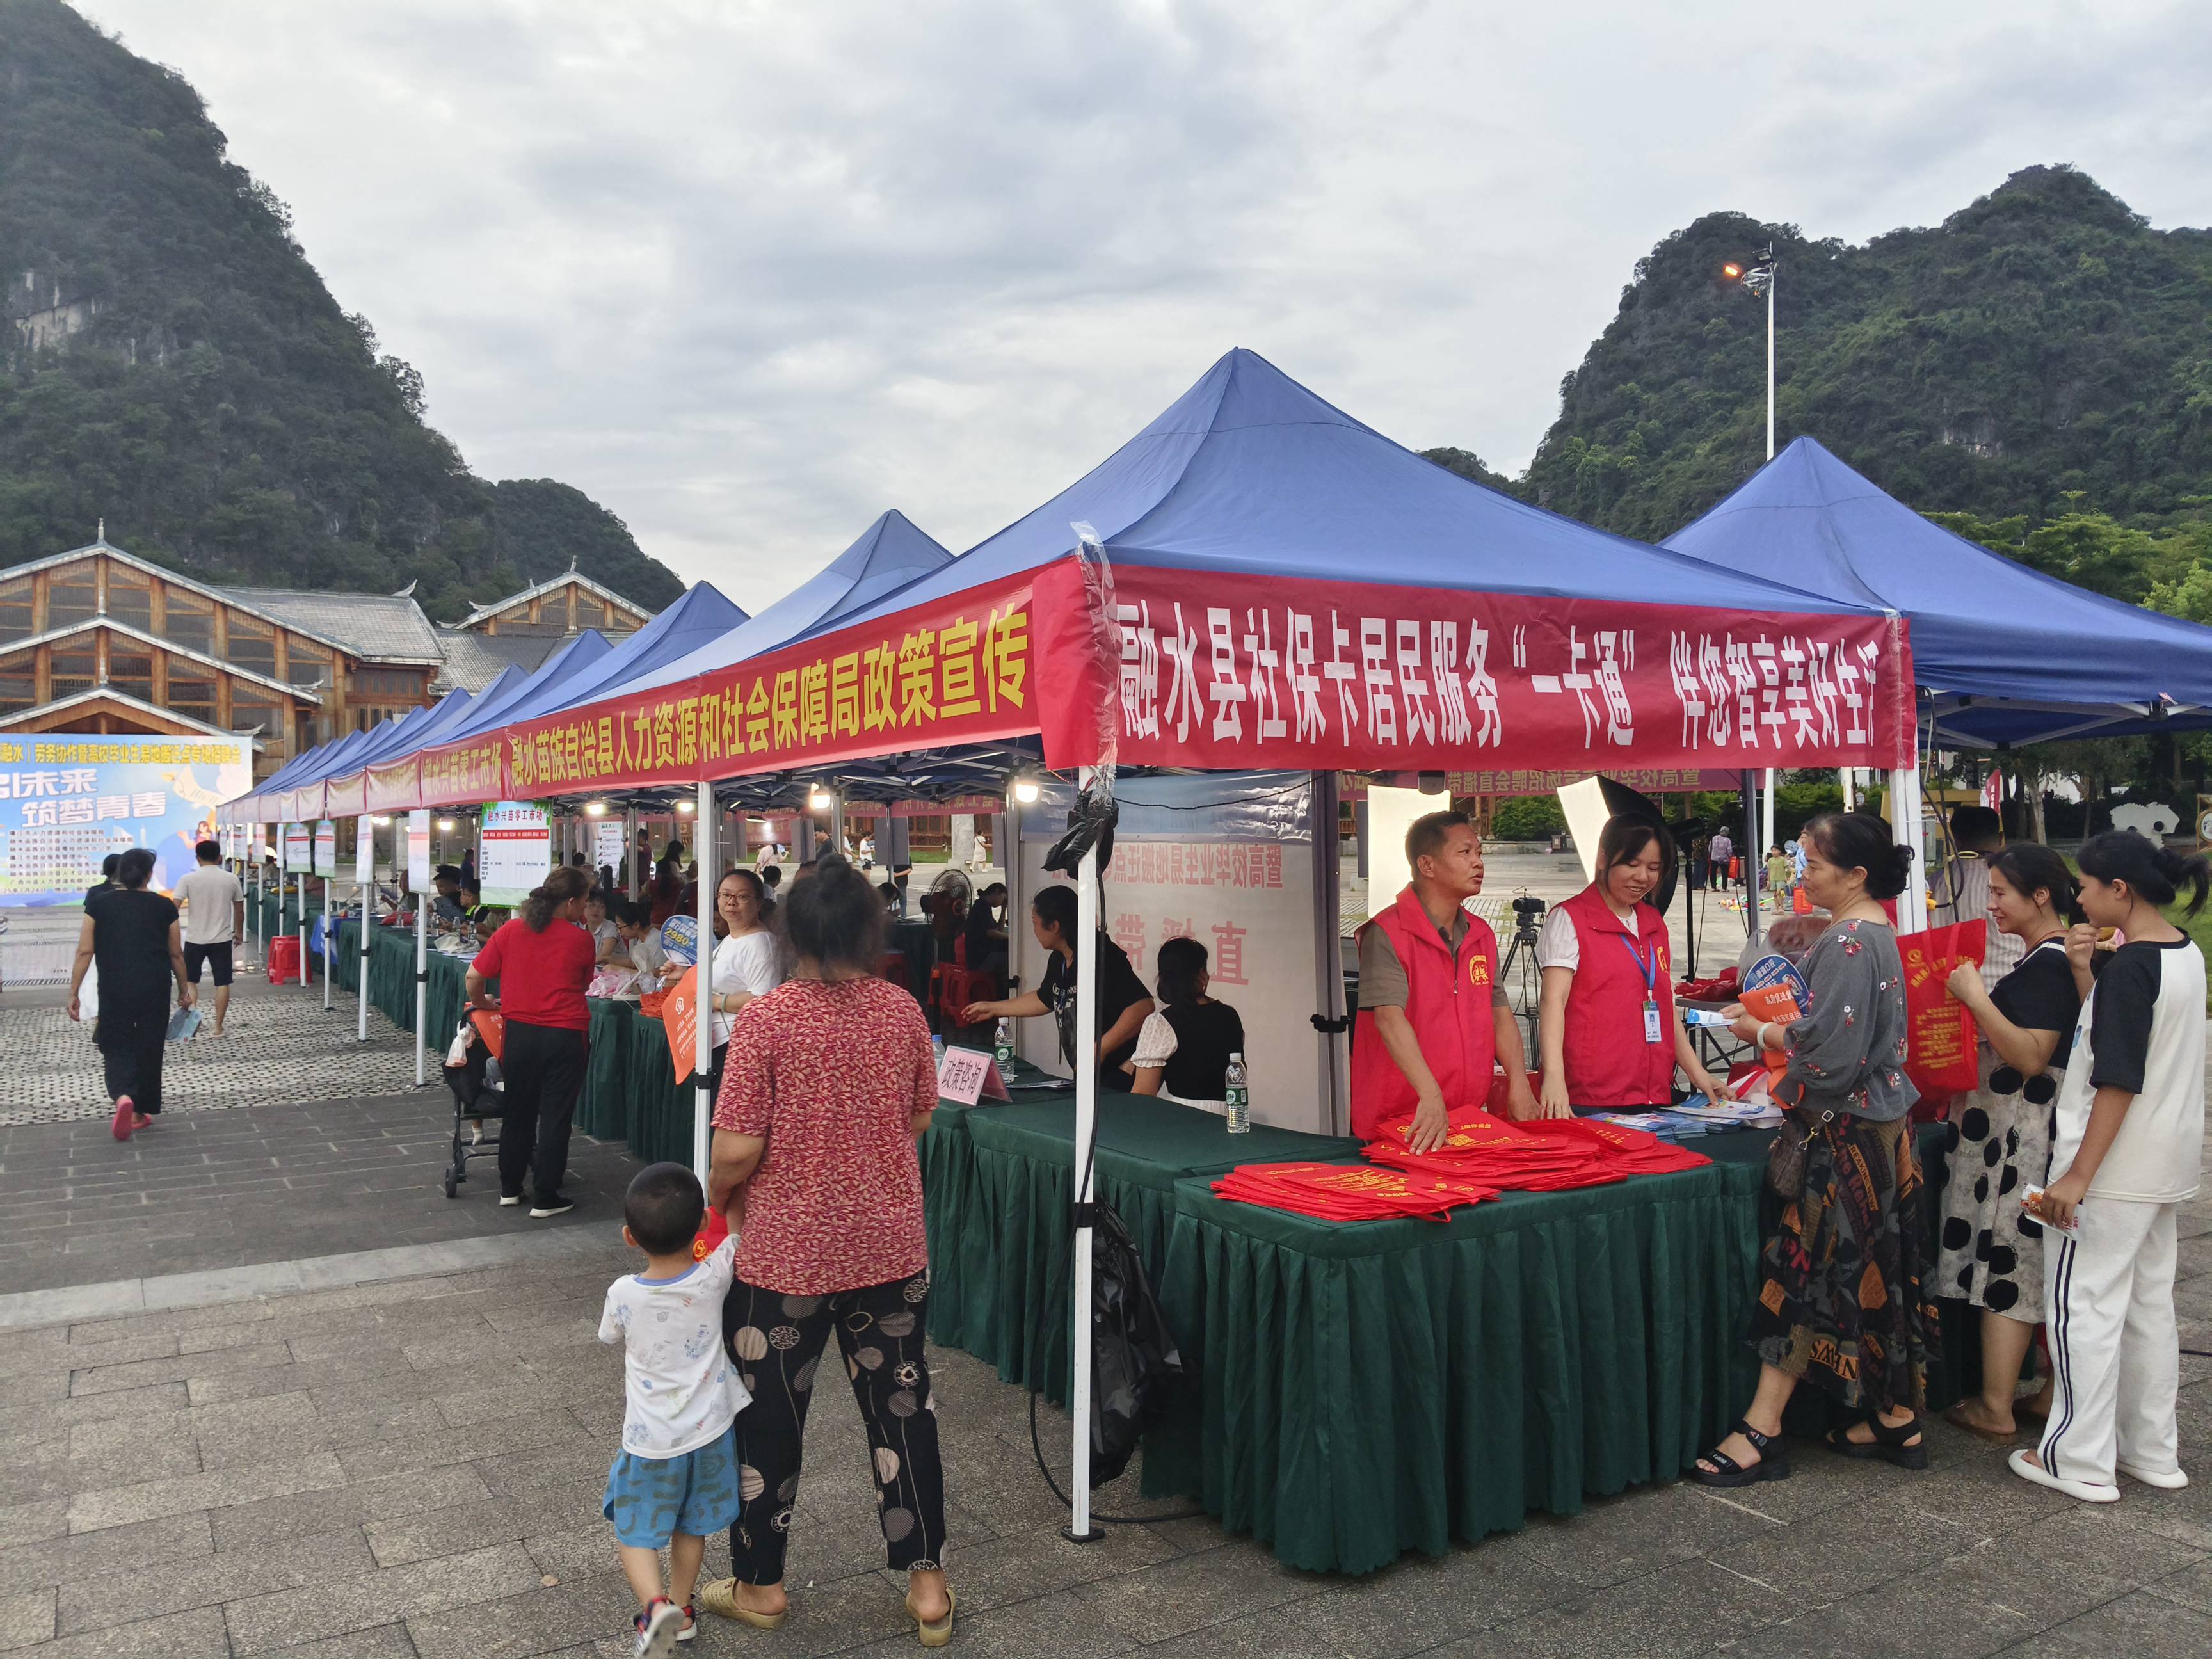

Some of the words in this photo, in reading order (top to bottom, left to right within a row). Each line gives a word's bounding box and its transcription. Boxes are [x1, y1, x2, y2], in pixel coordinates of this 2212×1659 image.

[511, 602, 1027, 787] 融水苗族自治县人力资源和社会保障局政策宣传
[423, 741, 502, 796] 融水兴苗零工市场
[22, 792, 166, 828] 筑梦青春
[488, 809, 543, 822] 融水兴苗零工市场
[664, 927, 689, 946] 2980
[942, 1057, 982, 1095] 政策咨询
